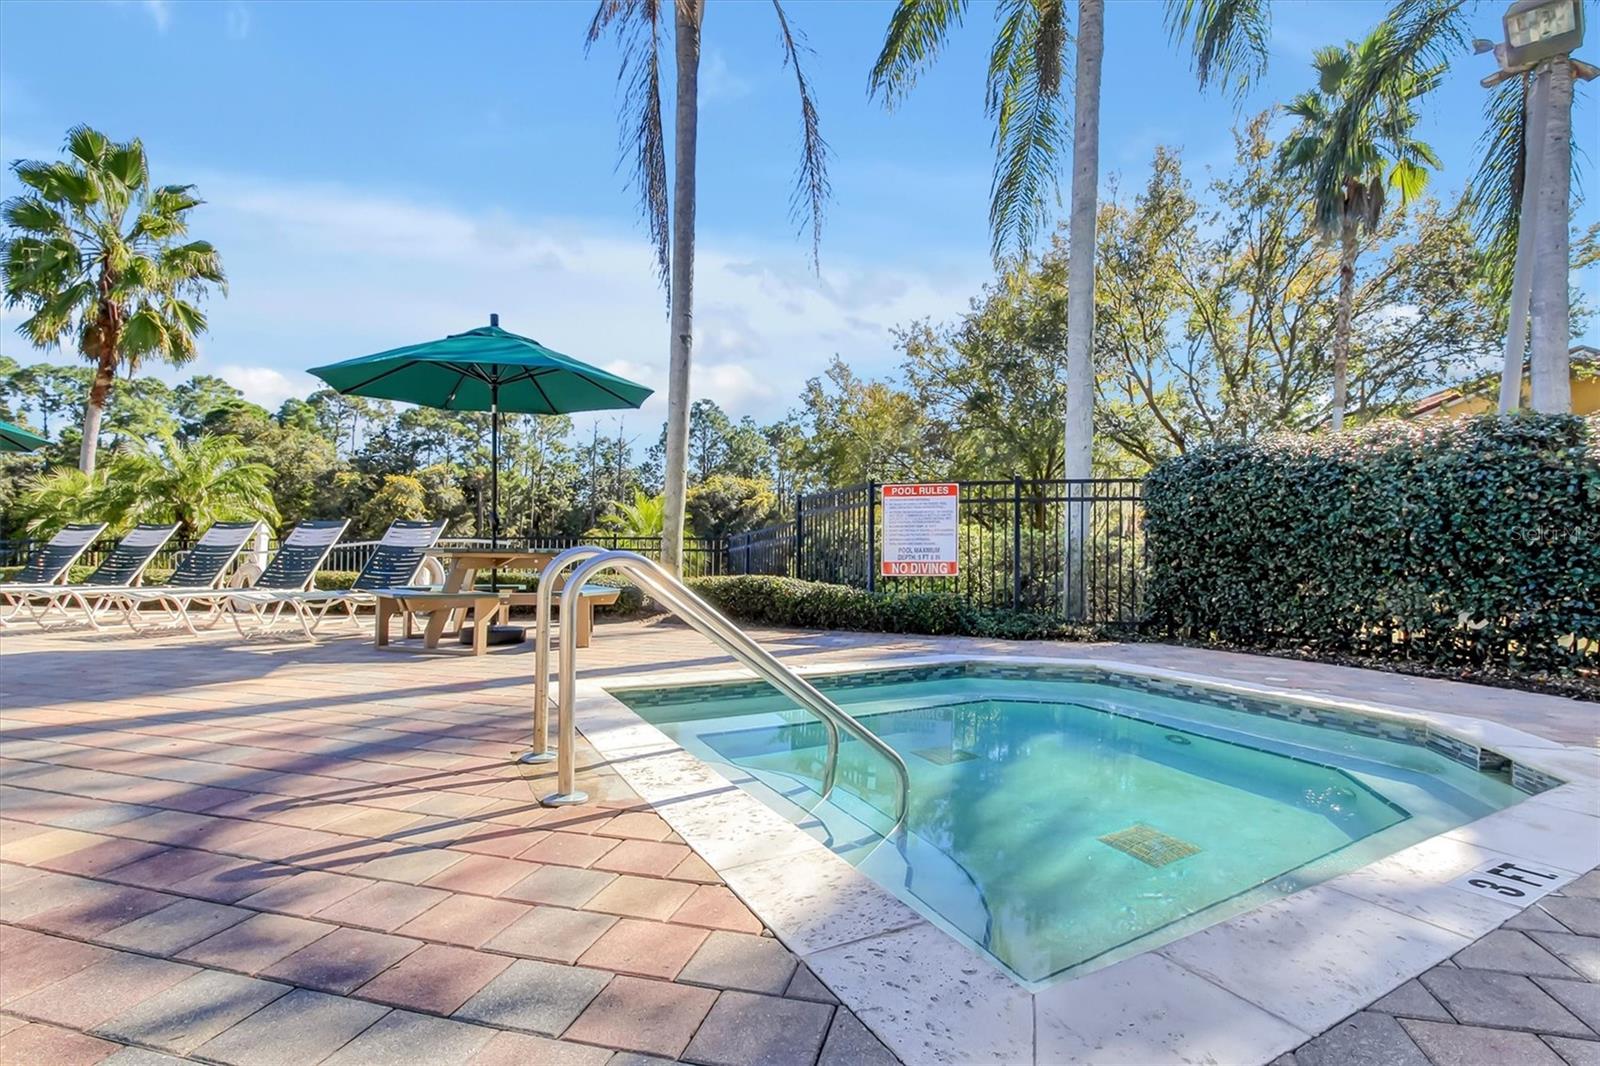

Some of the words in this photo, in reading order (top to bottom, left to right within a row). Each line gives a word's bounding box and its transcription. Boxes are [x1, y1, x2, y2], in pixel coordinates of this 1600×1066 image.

[891, 487, 917, 495] POOL
[919, 486, 949, 495] RULES
[892, 563, 908, 574] NO
[910, 563, 948, 574] DIVING
[1468, 879, 1525, 897] 3
